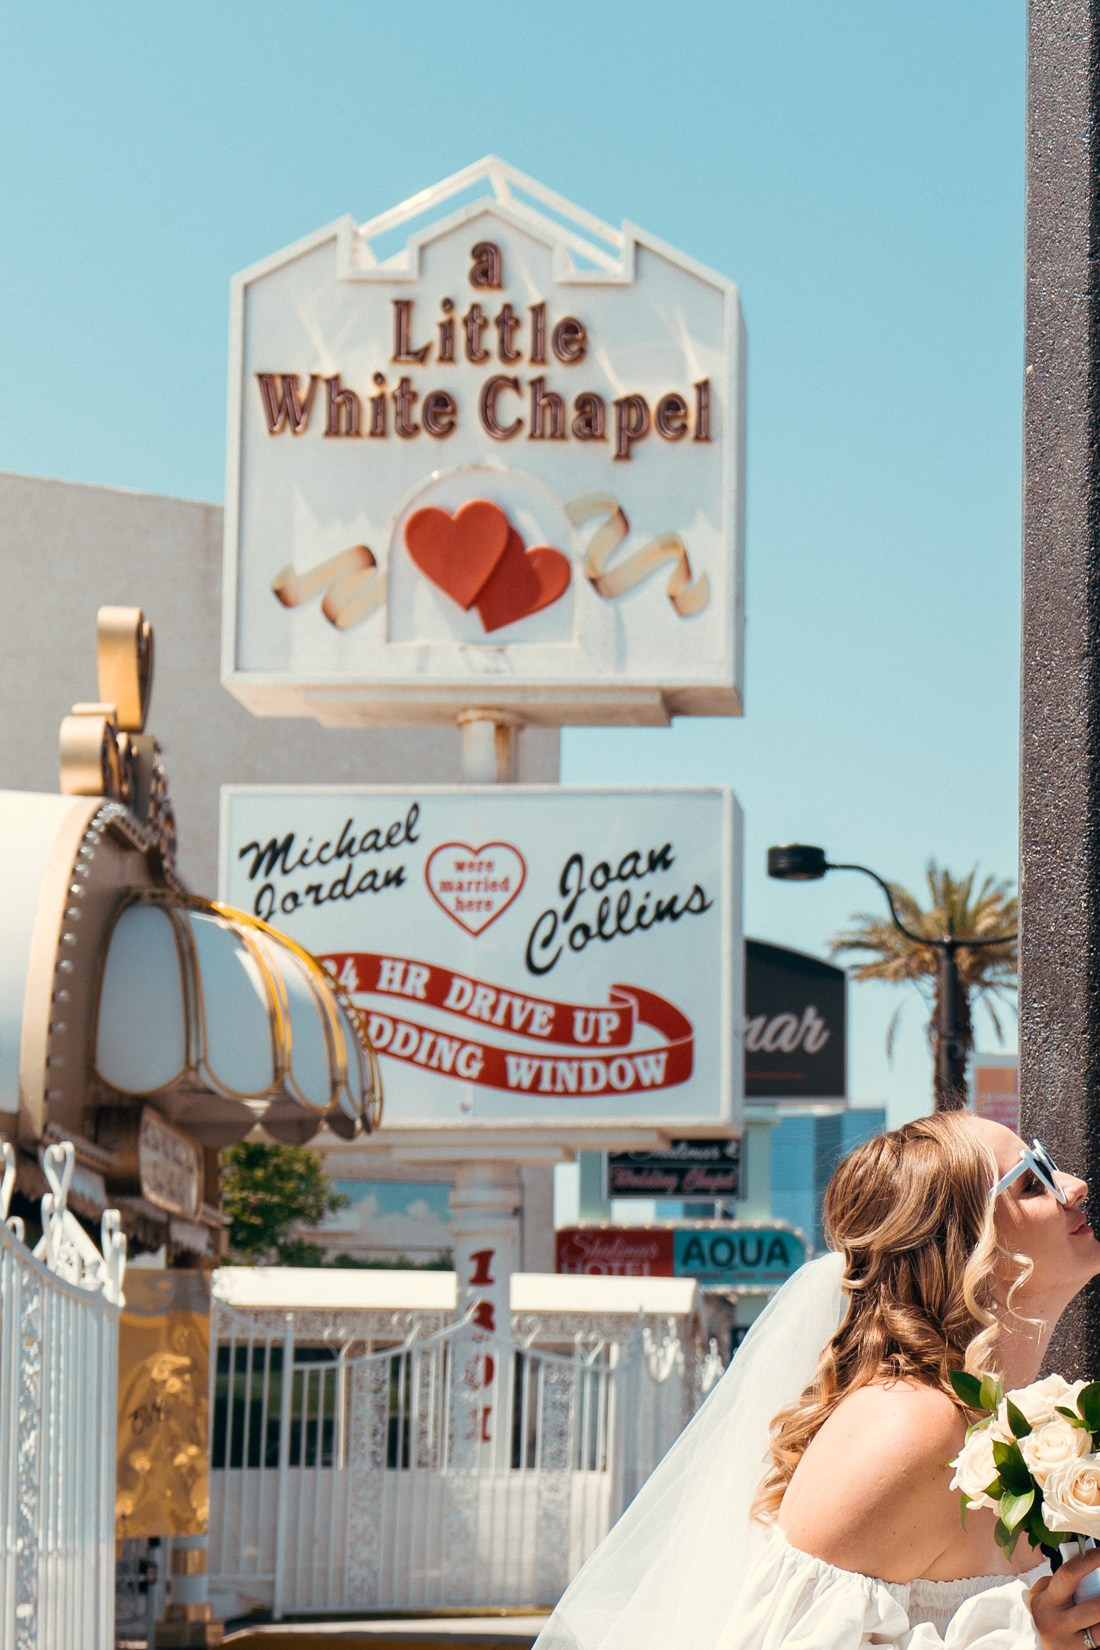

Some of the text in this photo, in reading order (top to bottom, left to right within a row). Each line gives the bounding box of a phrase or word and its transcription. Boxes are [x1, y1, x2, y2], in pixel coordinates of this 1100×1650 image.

[469, 241, 503, 289] a
[391, 297, 588, 364] Little
[256, 372, 711, 461] White Chapel
[239, 803, 420, 880] Michael
[454, 859, 494, 872] were
[254, 863, 406, 922] Jordan
[438, 876, 510, 893] married
[454, 896, 493, 911] here
[559, 843, 676, 922] Joan
[525, 884, 712, 975] Collins
[376, 957, 430, 1000] HR
[442, 975, 555, 1037] DRIVE
[572, 1010, 621, 1043] UP
[505, 1052, 668, 1093] WINDOW
[681, 1236, 792, 1270] AQUA
